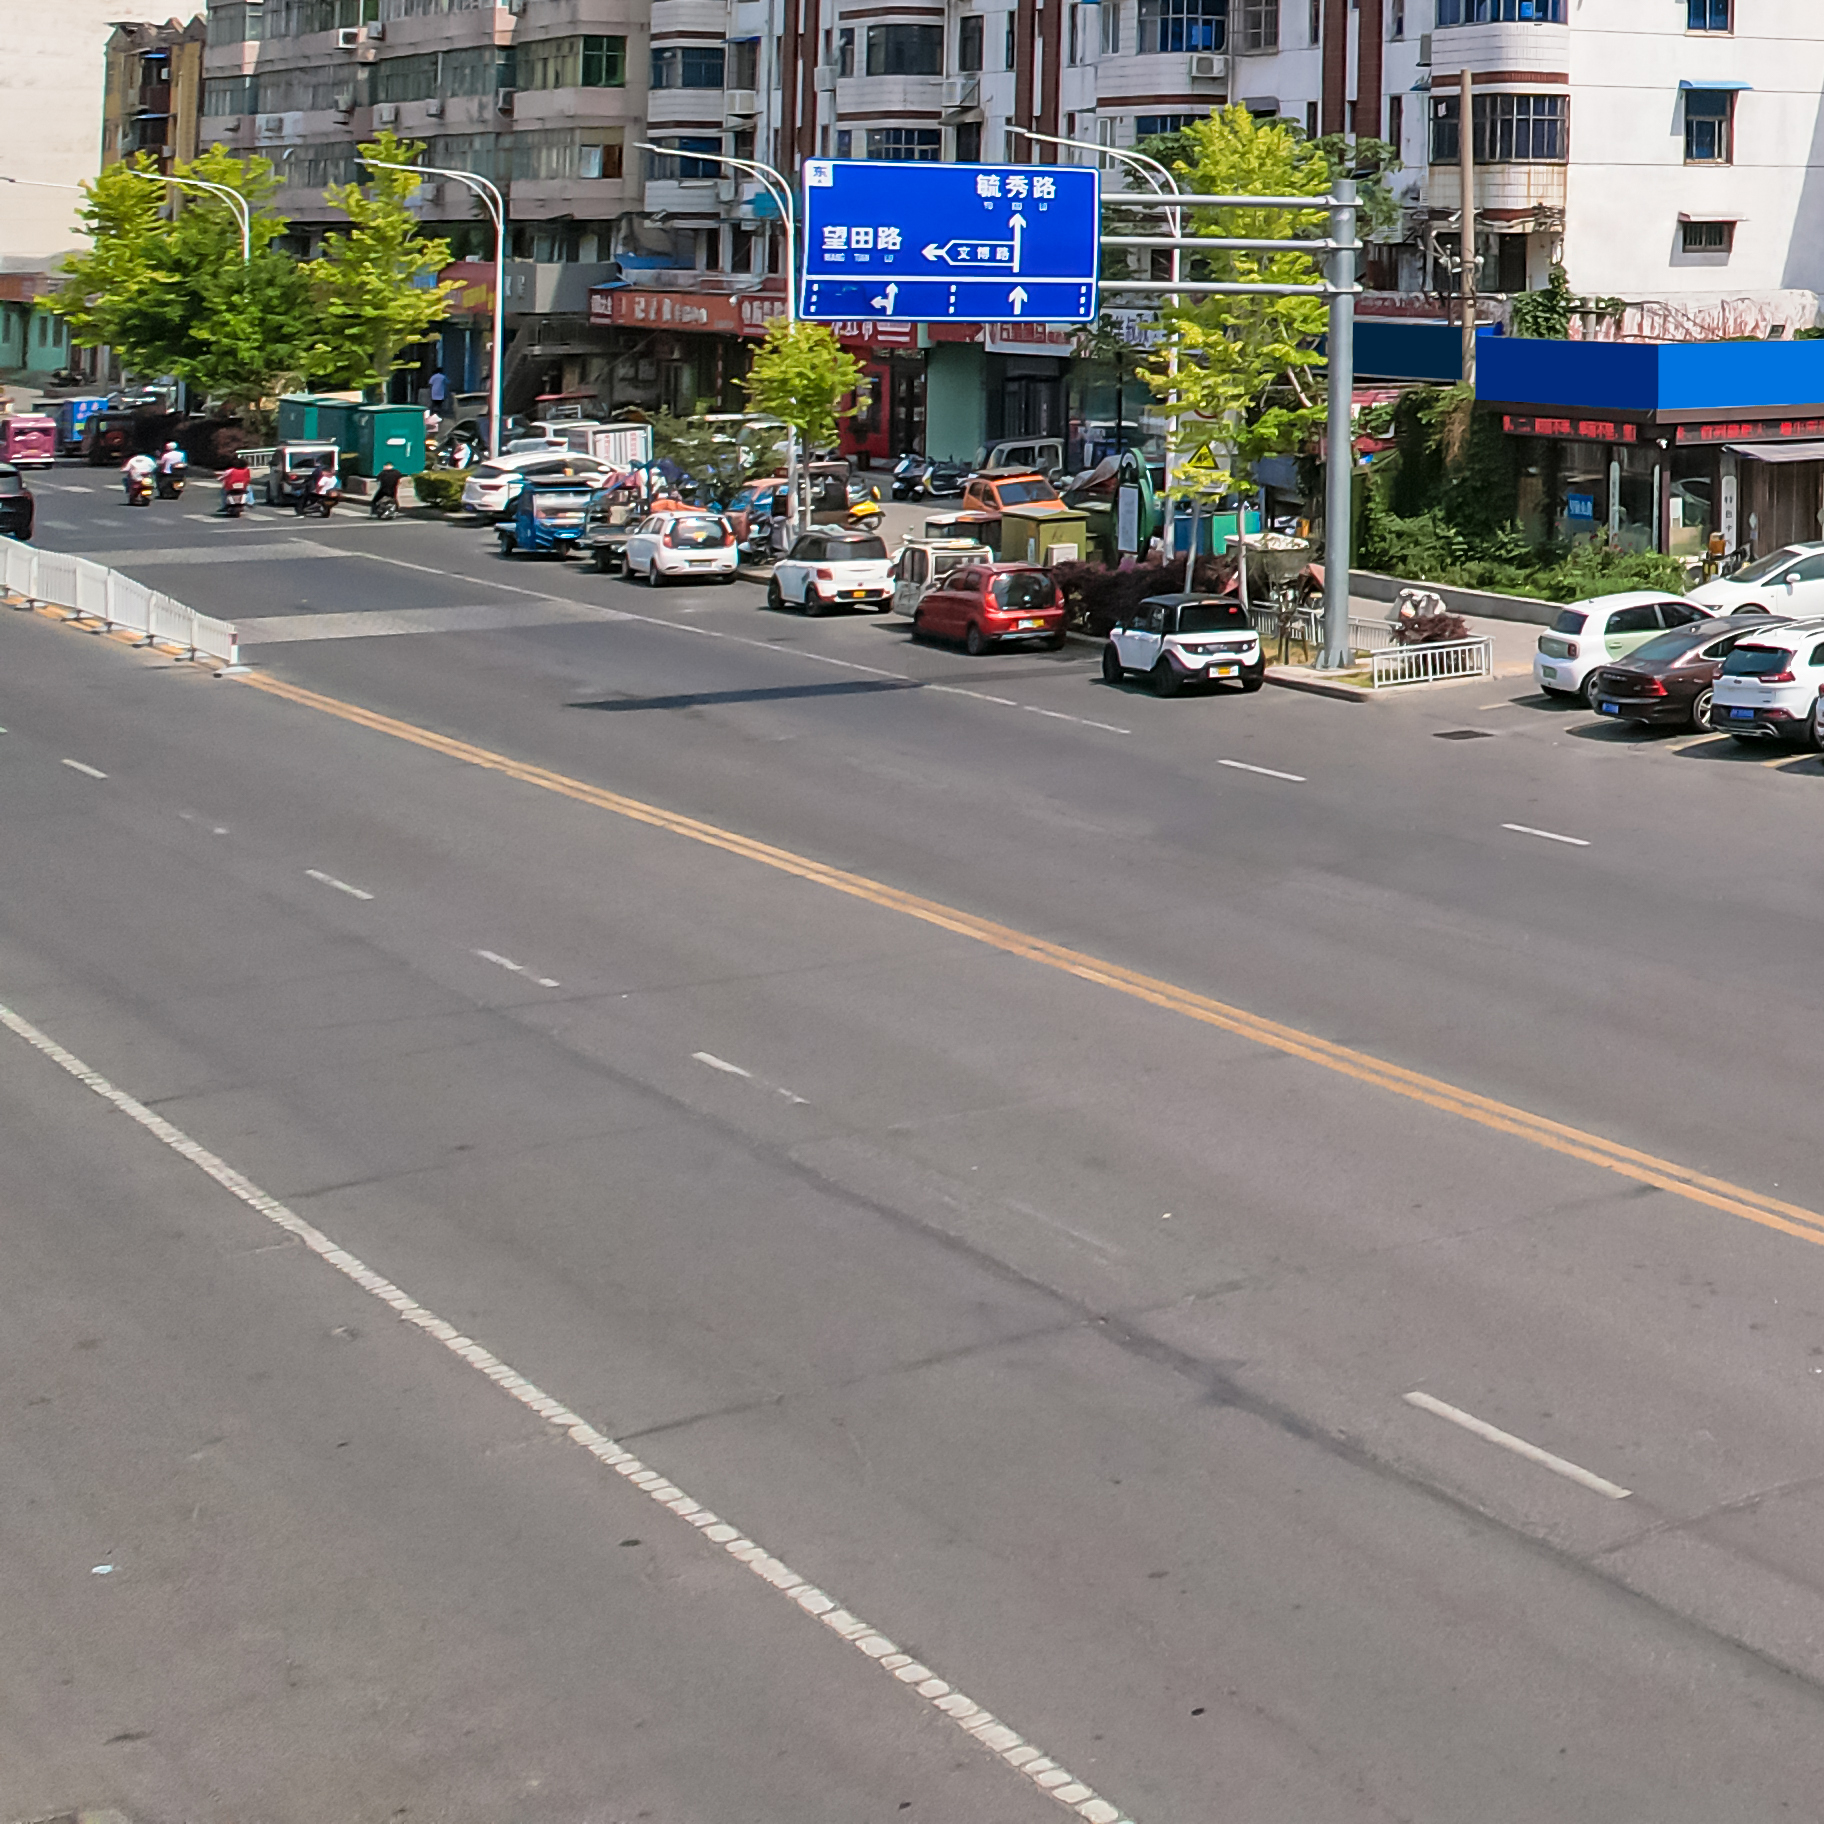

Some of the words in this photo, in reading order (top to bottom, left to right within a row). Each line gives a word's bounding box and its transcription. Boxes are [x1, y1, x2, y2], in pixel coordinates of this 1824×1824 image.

[812, 165, 828, 178] 东
[976, 174, 1056, 199] 毓秀路
[822, 226, 902, 250] 望田路
[957, 246, 1010, 261] 文博路
